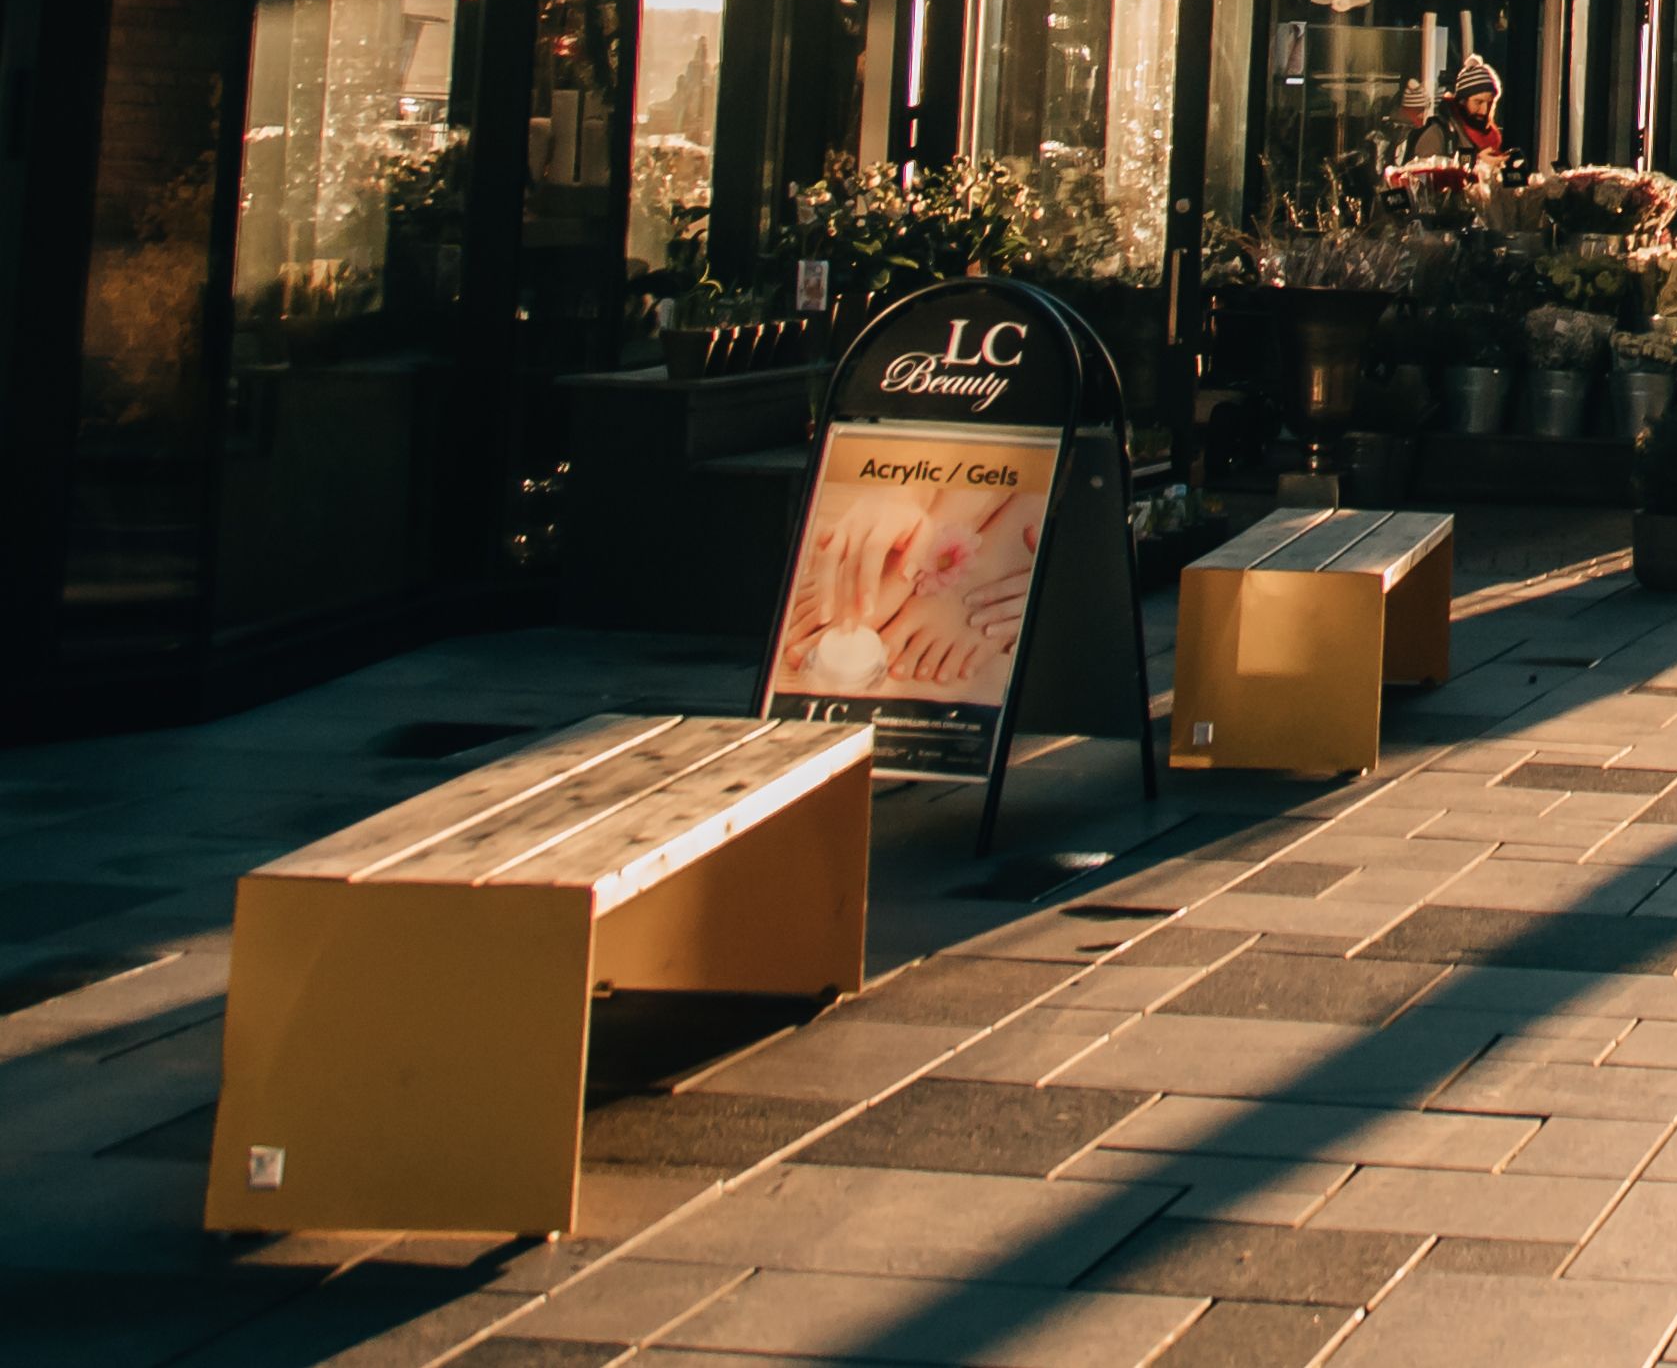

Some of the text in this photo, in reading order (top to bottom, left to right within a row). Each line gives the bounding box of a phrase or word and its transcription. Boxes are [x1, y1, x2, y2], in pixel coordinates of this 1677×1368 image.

[941, 319, 1028, 366] LC
[880, 351, 1010, 412] Beauty
[859, 458, 942, 485] Acrylic
[966, 464, 1018, 486] Gels
